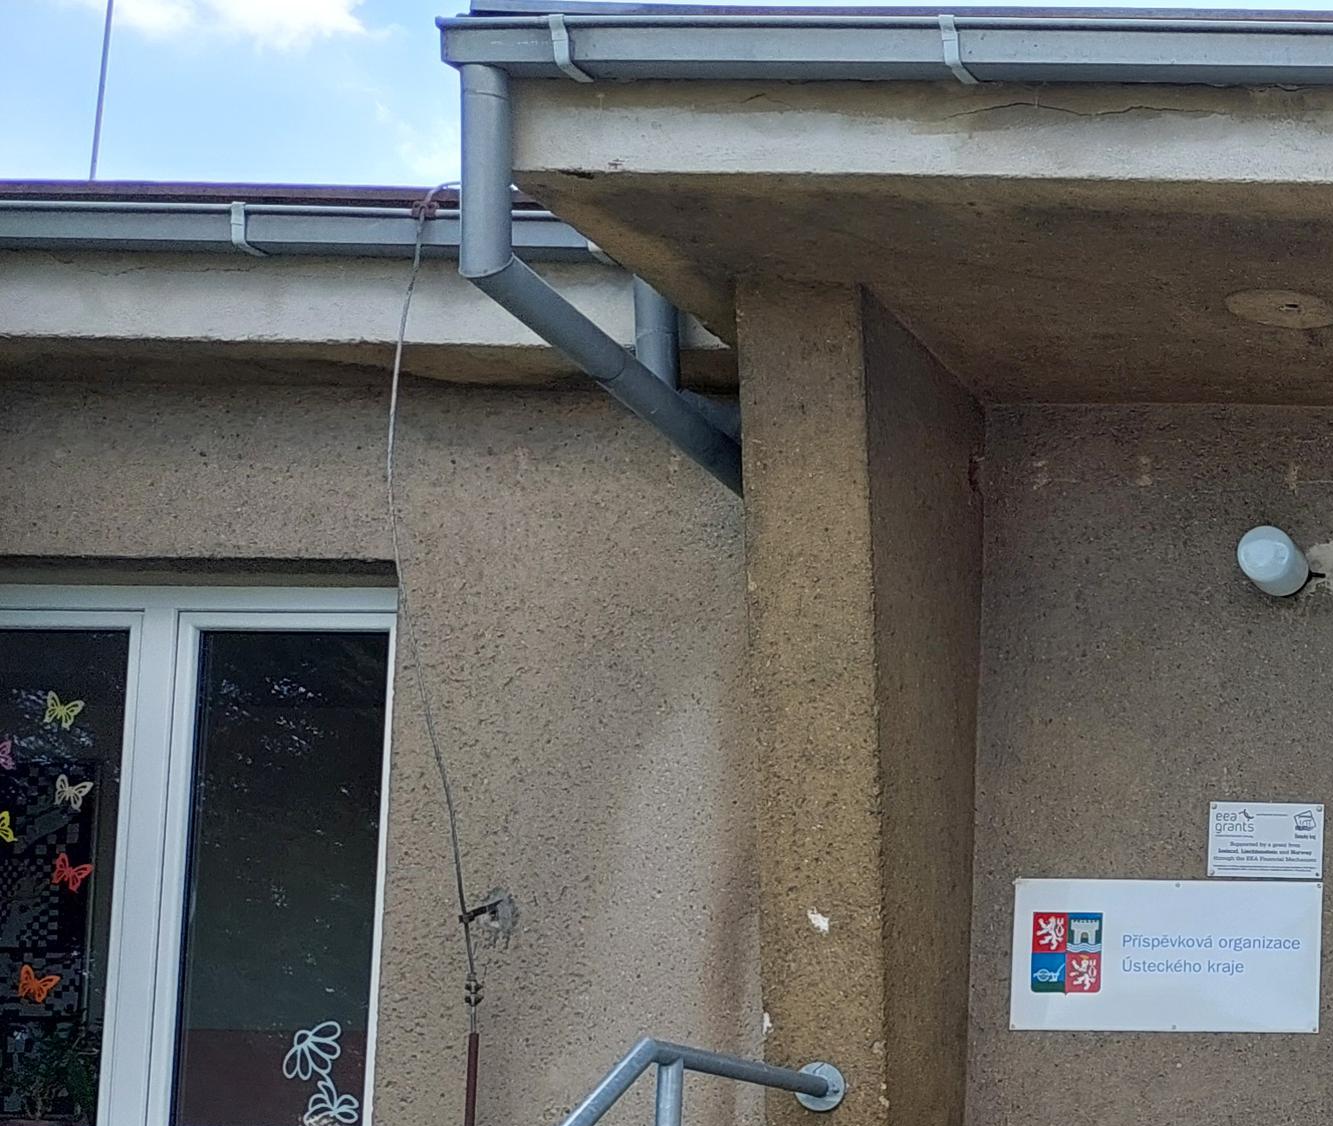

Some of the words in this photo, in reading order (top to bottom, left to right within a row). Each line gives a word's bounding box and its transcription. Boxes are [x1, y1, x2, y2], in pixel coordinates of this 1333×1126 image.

[1215, 812, 1237, 821] eea
[1215, 821, 1255, 834] grants
[1122, 934, 1213, 950] Příspěvková
[1218, 935, 1301, 951] organizace
[1122, 956, 1202, 973] Ústeckého
[1207, 960, 1245, 976] kraje
